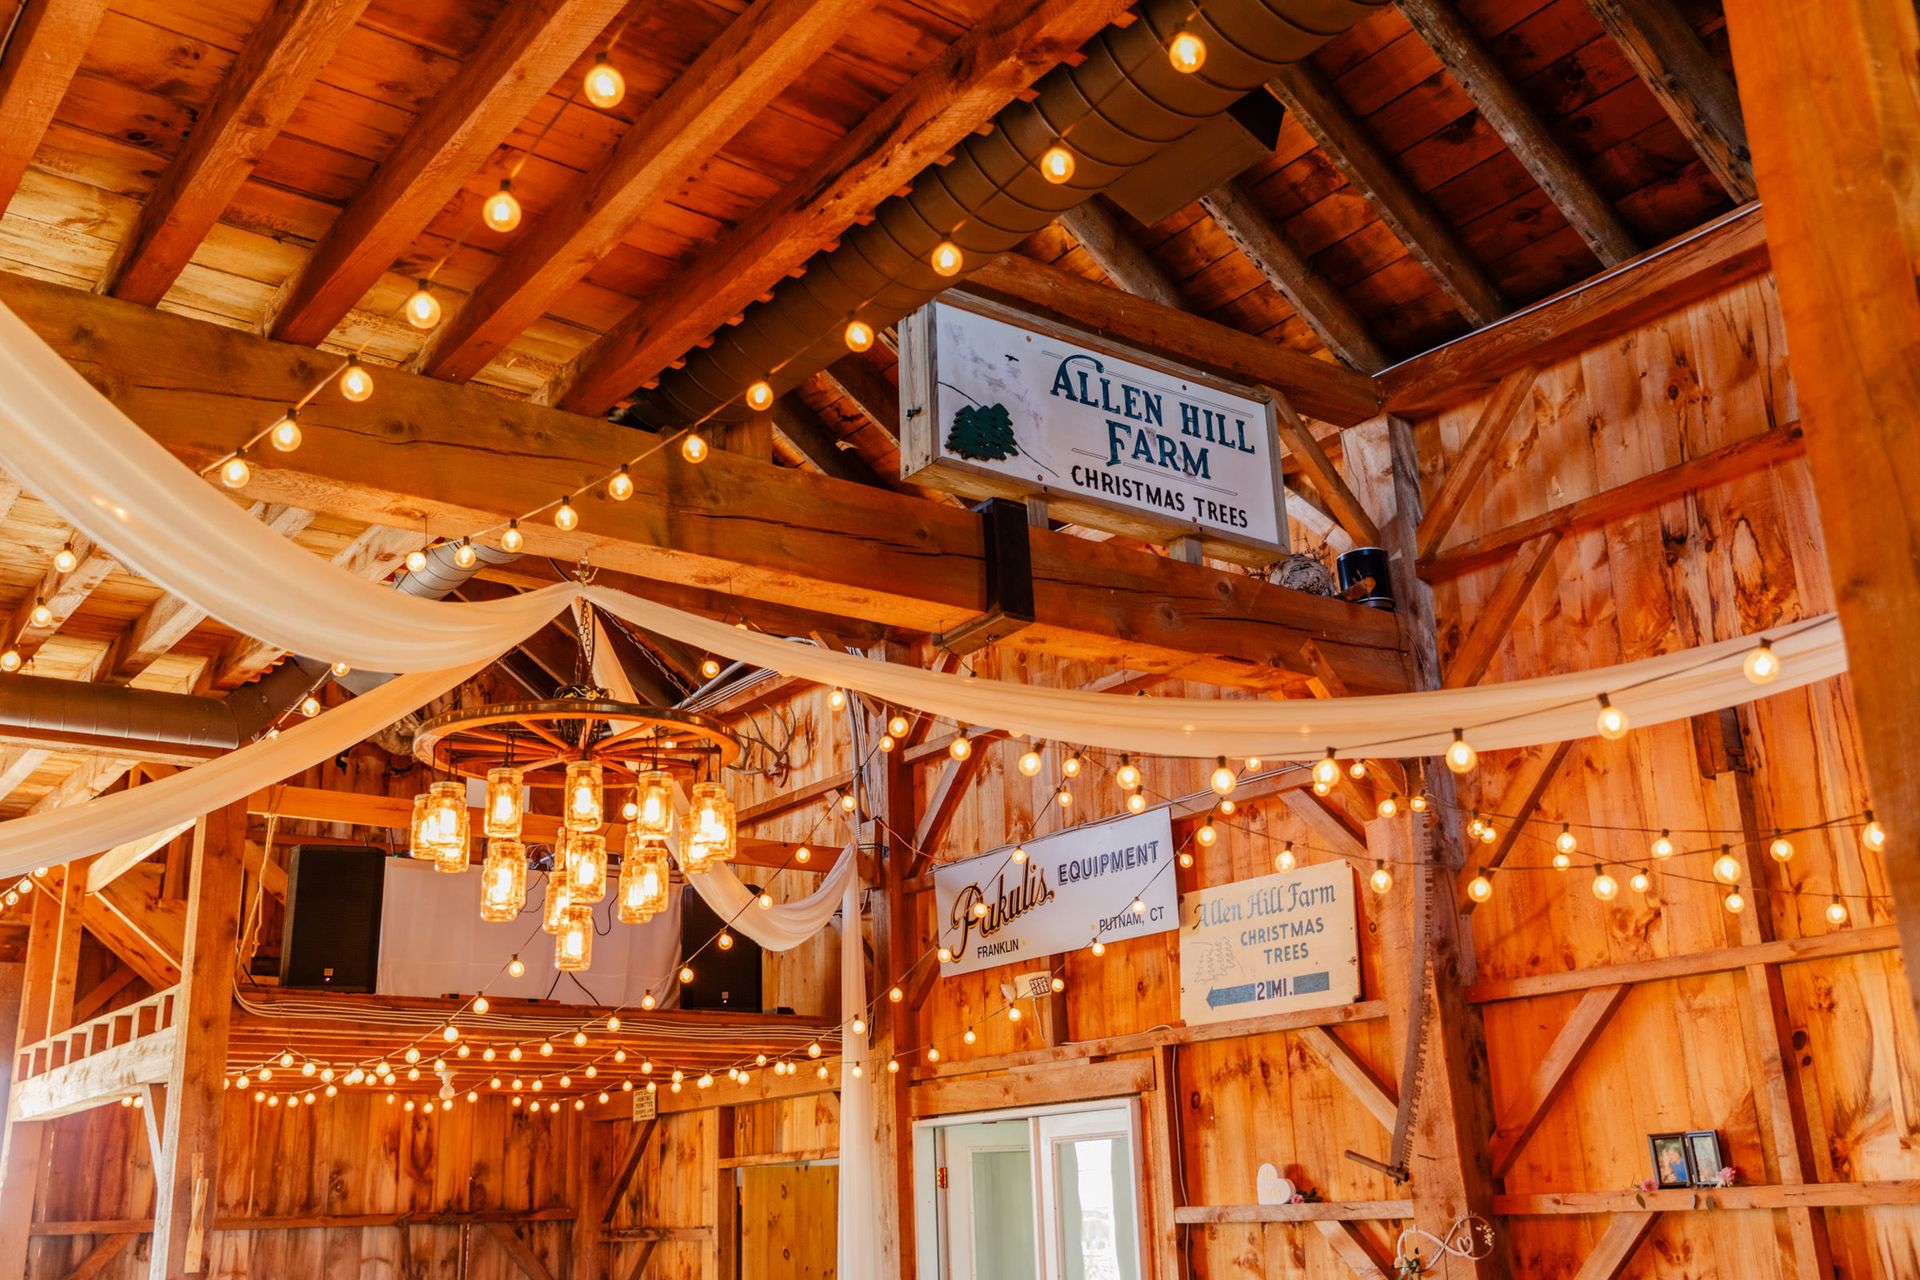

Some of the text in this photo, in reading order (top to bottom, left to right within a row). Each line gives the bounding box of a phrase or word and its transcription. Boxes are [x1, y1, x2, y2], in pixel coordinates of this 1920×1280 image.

[1050, 354, 1255, 455] ALLEN HILL
[1105, 419, 1212, 480] FARM
[1071, 465, 1249, 529] CHRISTMAS TREES
[1058, 840, 1159, 886] EQUIPMENT
[1099, 906, 1164, 931] PUTNAM, CT
[1192, 882, 1336, 931] Allen Hill Farm
[977, 938, 1019, 959] FRANKLIN
[1240, 917, 1325, 947] CHRISTMAS
[1264, 942, 1309, 965] TREES
[1256, 978, 1293, 1001] 2 MI.
